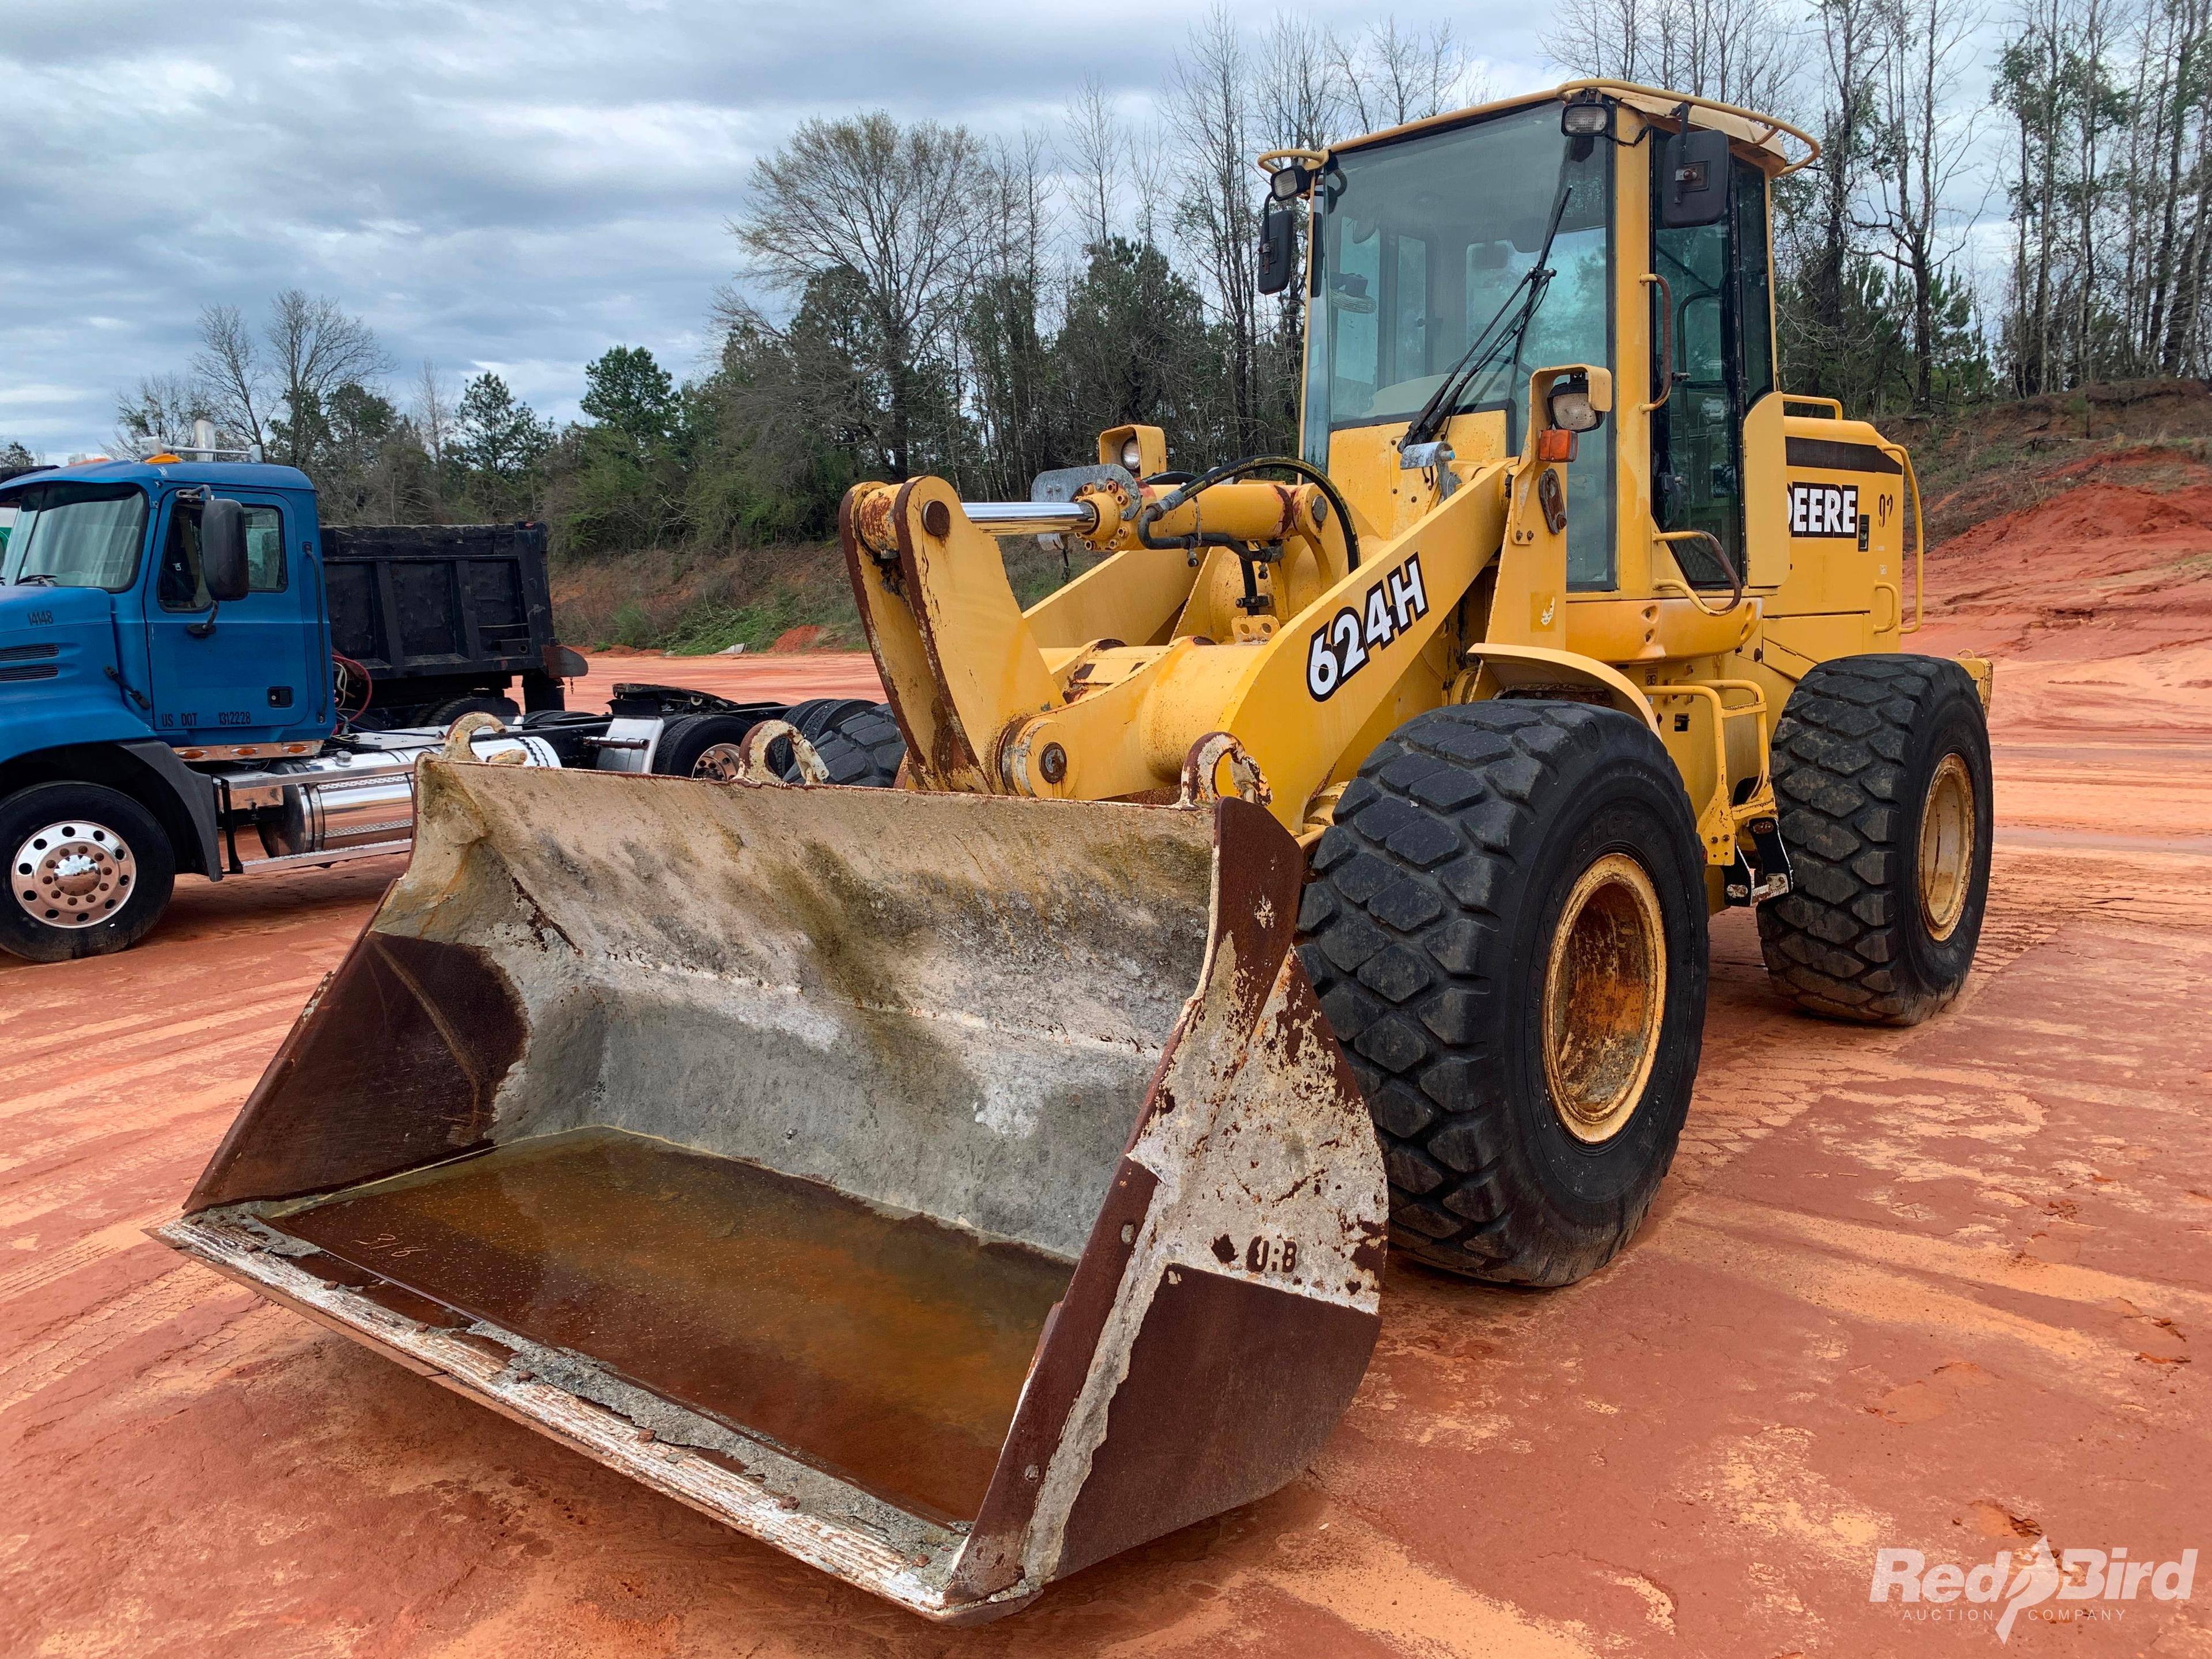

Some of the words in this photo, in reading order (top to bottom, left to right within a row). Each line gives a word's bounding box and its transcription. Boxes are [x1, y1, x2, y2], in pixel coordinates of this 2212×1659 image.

[1308, 556, 1427, 698] 624H
[161, 713, 173, 727] US
[181, 713, 198, 726] DOT
[218, 711, 251, 725] 1312228
